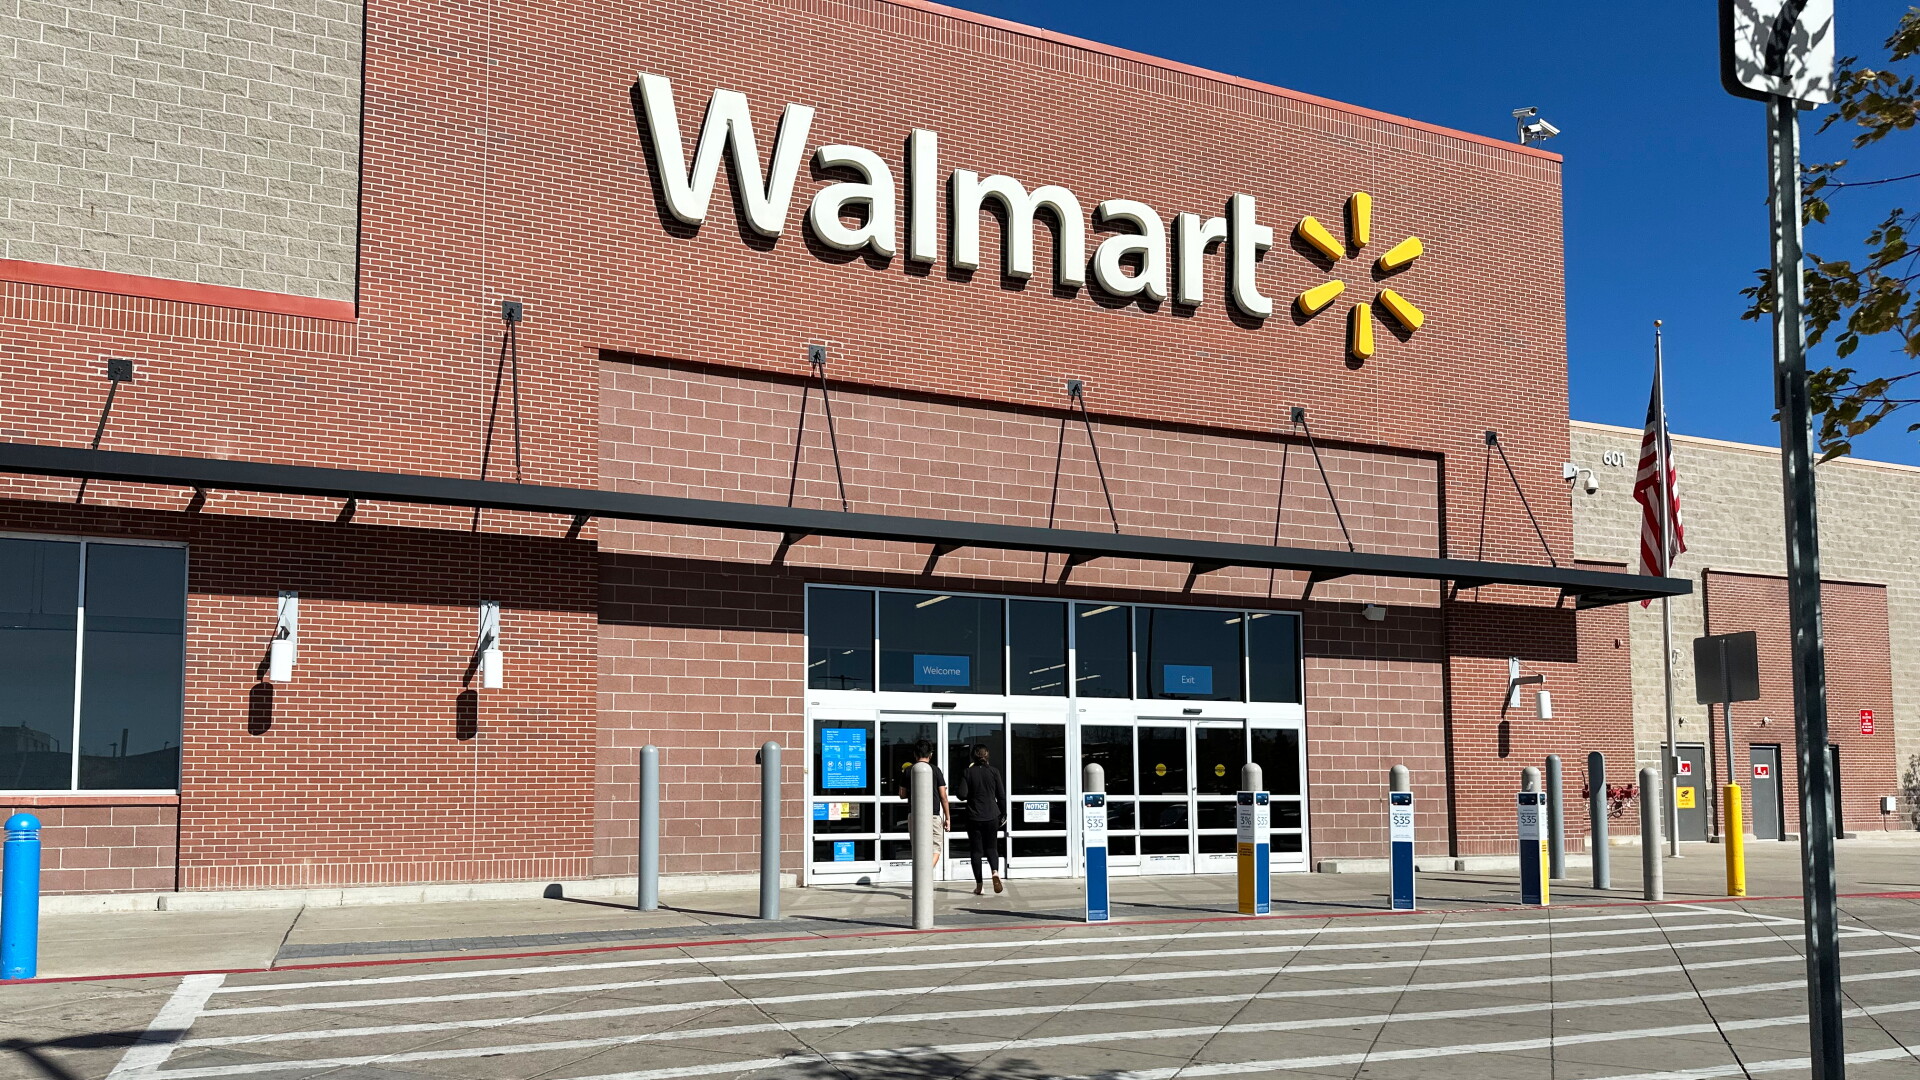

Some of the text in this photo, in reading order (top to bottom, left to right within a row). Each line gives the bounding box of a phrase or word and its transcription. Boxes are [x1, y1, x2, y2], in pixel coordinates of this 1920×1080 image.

[637, 72, 1273, 319] Walmart
[1603, 450, 1625, 467] 601
[922, 665, 961, 676] Welcome
[1181, 675, 1195, 684] Exit
[1086, 818, 1104, 829] $35
[1240, 816, 1251, 826] 3%
[1257, 816, 1268, 826] $35
[1393, 815, 1411, 825] $35
[1520, 814, 1537, 824] $35
